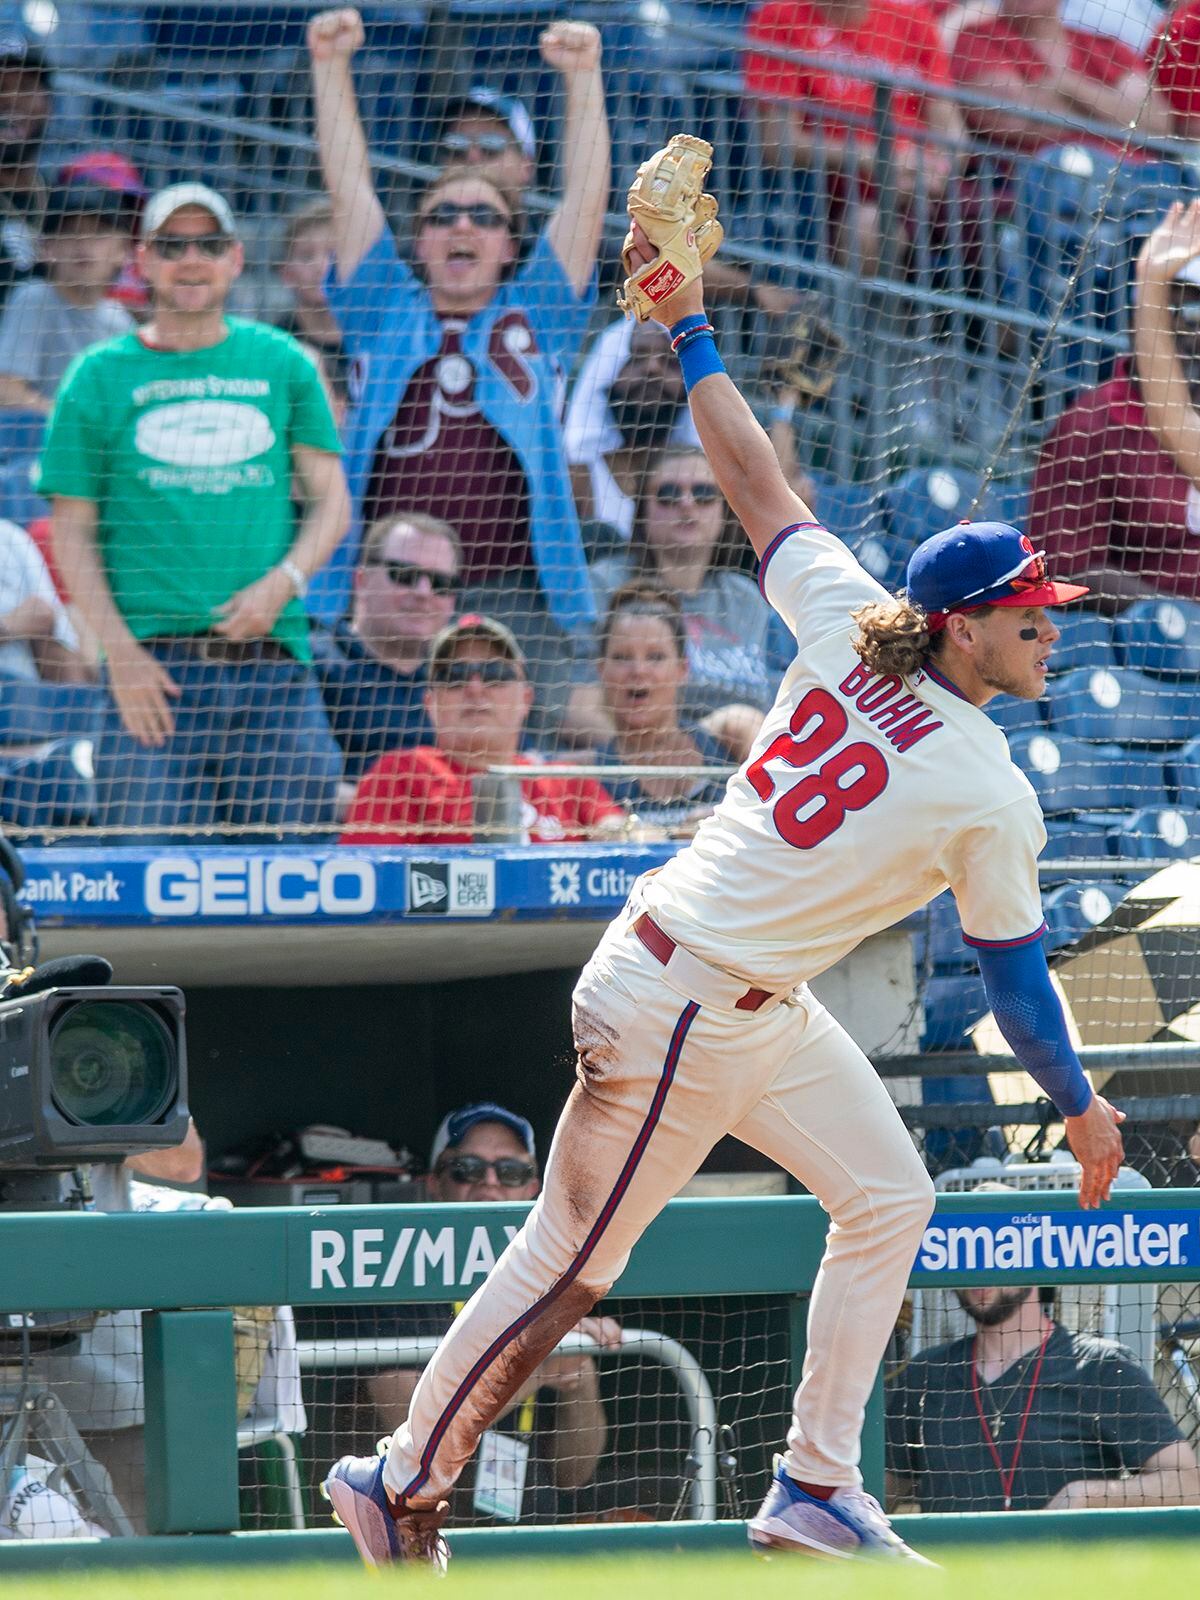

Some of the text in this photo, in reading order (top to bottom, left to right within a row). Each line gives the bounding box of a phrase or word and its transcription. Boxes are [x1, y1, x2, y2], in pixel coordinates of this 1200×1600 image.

[838, 661, 944, 753] BOHM
[745, 687, 890, 850] 28
[16, 871, 120, 901] ank Park
[145, 858, 375, 916] GEICO
[457, 873, 488, 889] NEW
[457, 889, 488, 906] ERA
[920, 1214, 1188, 1271] smartwater
